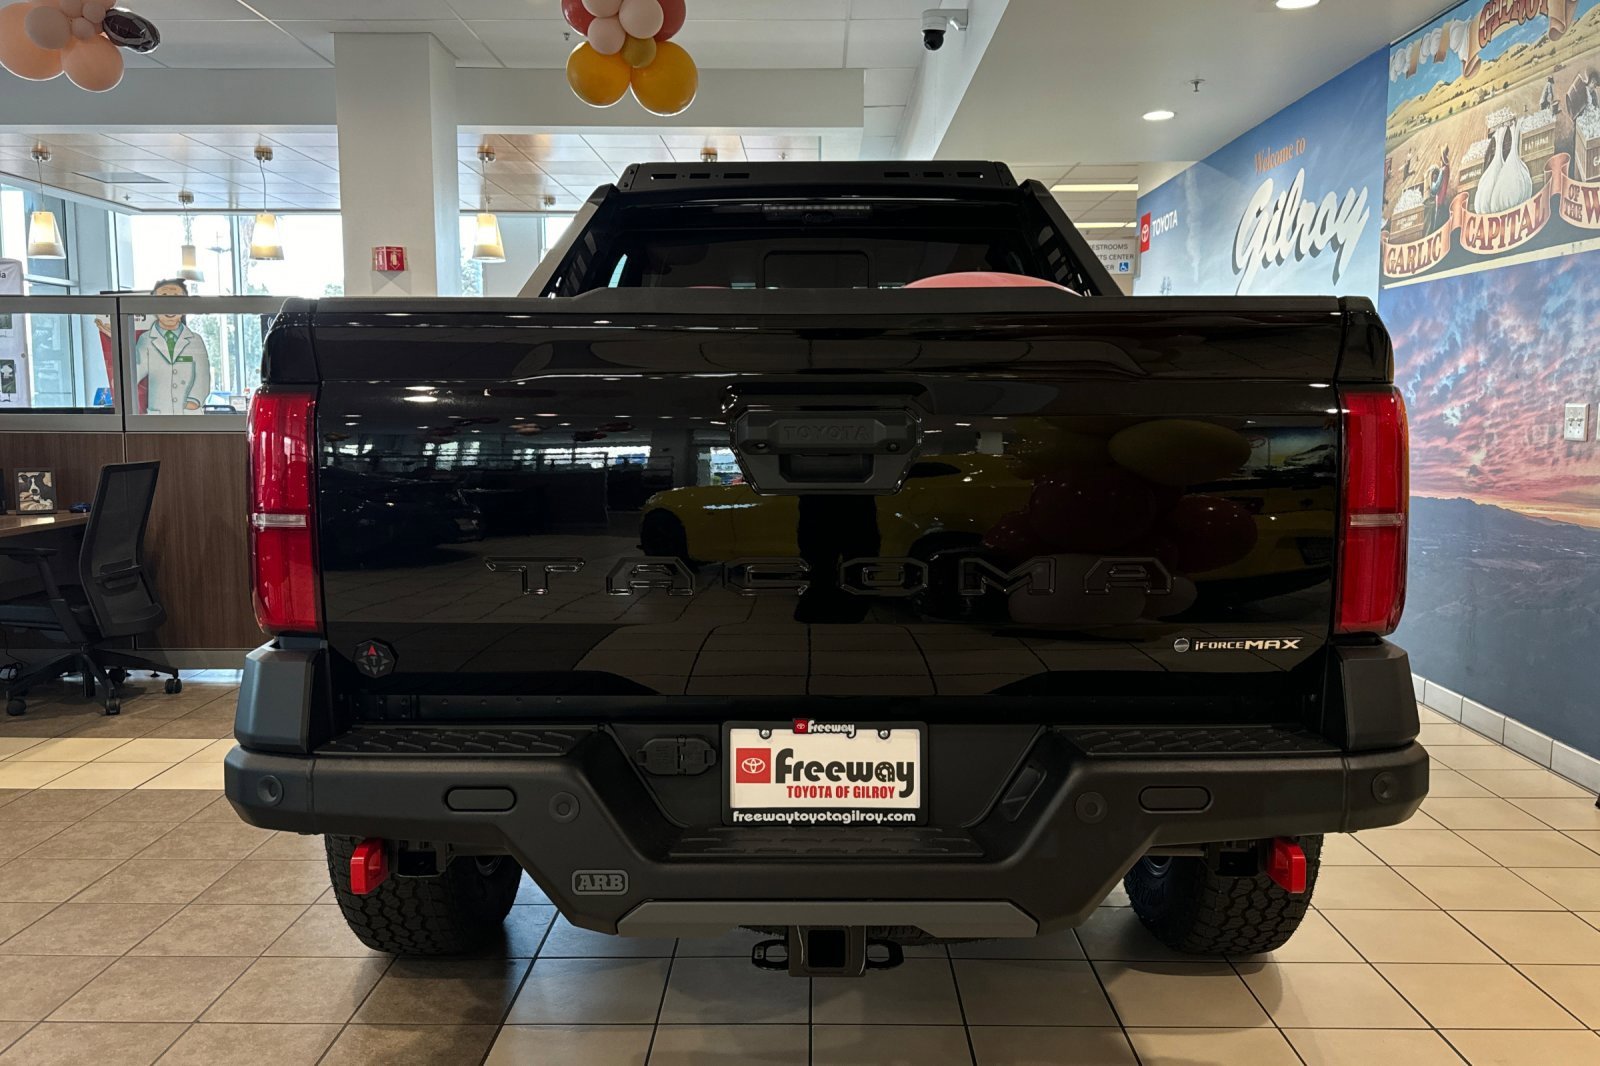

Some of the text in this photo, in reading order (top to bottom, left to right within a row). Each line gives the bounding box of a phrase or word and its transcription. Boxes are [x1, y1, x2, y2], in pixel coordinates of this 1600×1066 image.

[1254, 137, 1306, 176] Welcome to
[1568, 184, 1581, 203] OF
[1465, 192, 1546, 250] CAPITAL
[1563, 197, 1583, 223] THE
[1151, 209, 1178, 239] TOYOTA
[1232, 167, 1370, 296] Gilroy
[1108, 253, 1135, 261] CENTER
[1386, 231, 1442, 275] GARLIC
[784, 425, 870, 441] TOYOTA
[482, 555, 1176, 597] TACOMA
[807, 720, 855, 738] freeway
[775, 748, 915, 798] freeway
[786, 785, 896, 799] TOYOTA OF GILROY
[732, 809, 917, 825] freewaytoyotagilroy.com
[577, 874, 624, 891] ARB
